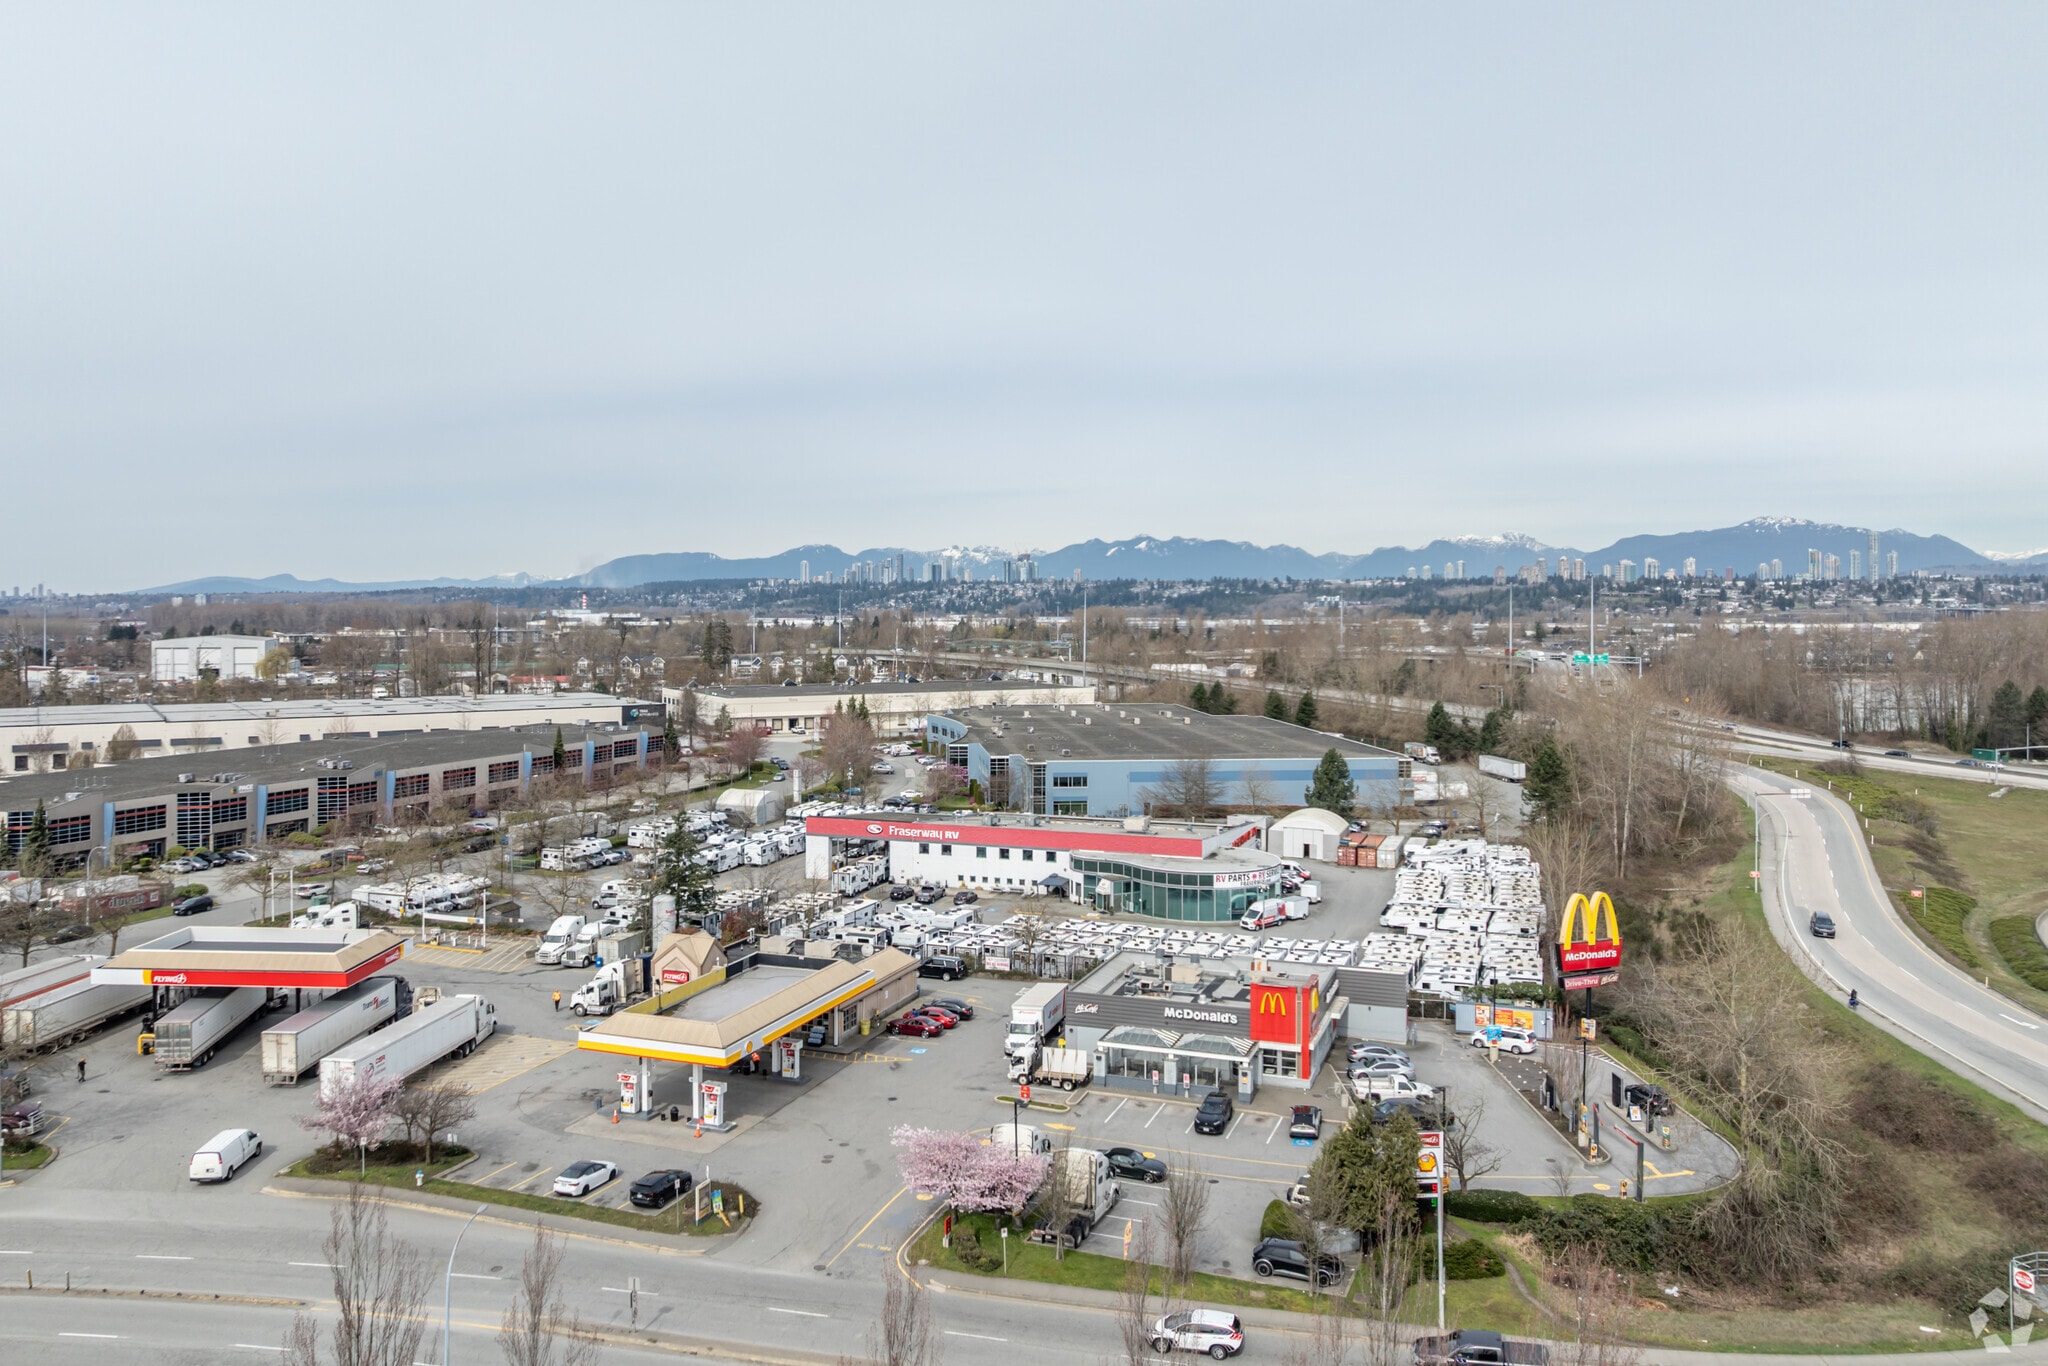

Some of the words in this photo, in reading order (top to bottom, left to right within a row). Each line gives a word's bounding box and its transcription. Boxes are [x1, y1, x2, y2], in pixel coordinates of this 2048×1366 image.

[888, 825, 943, 840] Fraserway
[944, 831, 959, 839] RV
[1228, 873, 1250, 882] PARTS
[1565, 949, 1618, 962] McDonald's
[1566, 979, 1599, 988] Drive-Thru
[1164, 1007, 1239, 1024] McDonald's
